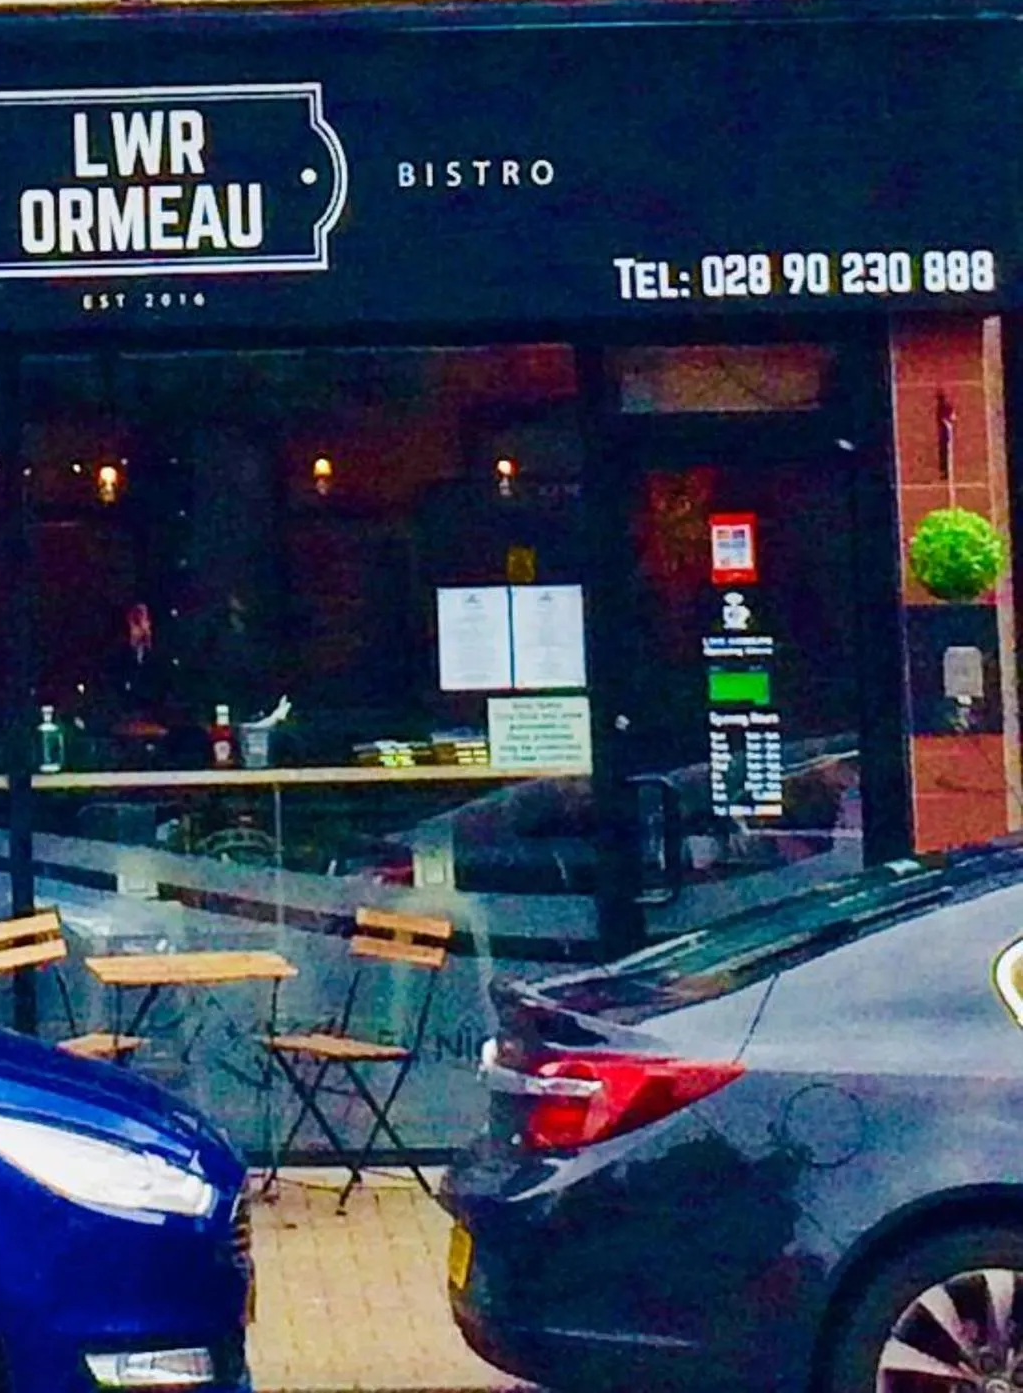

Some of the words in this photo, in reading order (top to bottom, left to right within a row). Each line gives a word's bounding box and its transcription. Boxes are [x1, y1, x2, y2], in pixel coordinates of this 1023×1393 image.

[73, 109, 206, 178] LWR
[398, 159, 554, 187] BISTRO
[20, 183, 263, 253] ORMEAU
[613, 257, 691, 299] TEL:
[701, 255, 772, 297] 028
[783, 253, 830, 295] 90
[841, 251, 913, 294] 230
[923, 250, 995, 293] 888
[83, 293, 125, 310] EST
[145, 293, 205, 308] 2016
